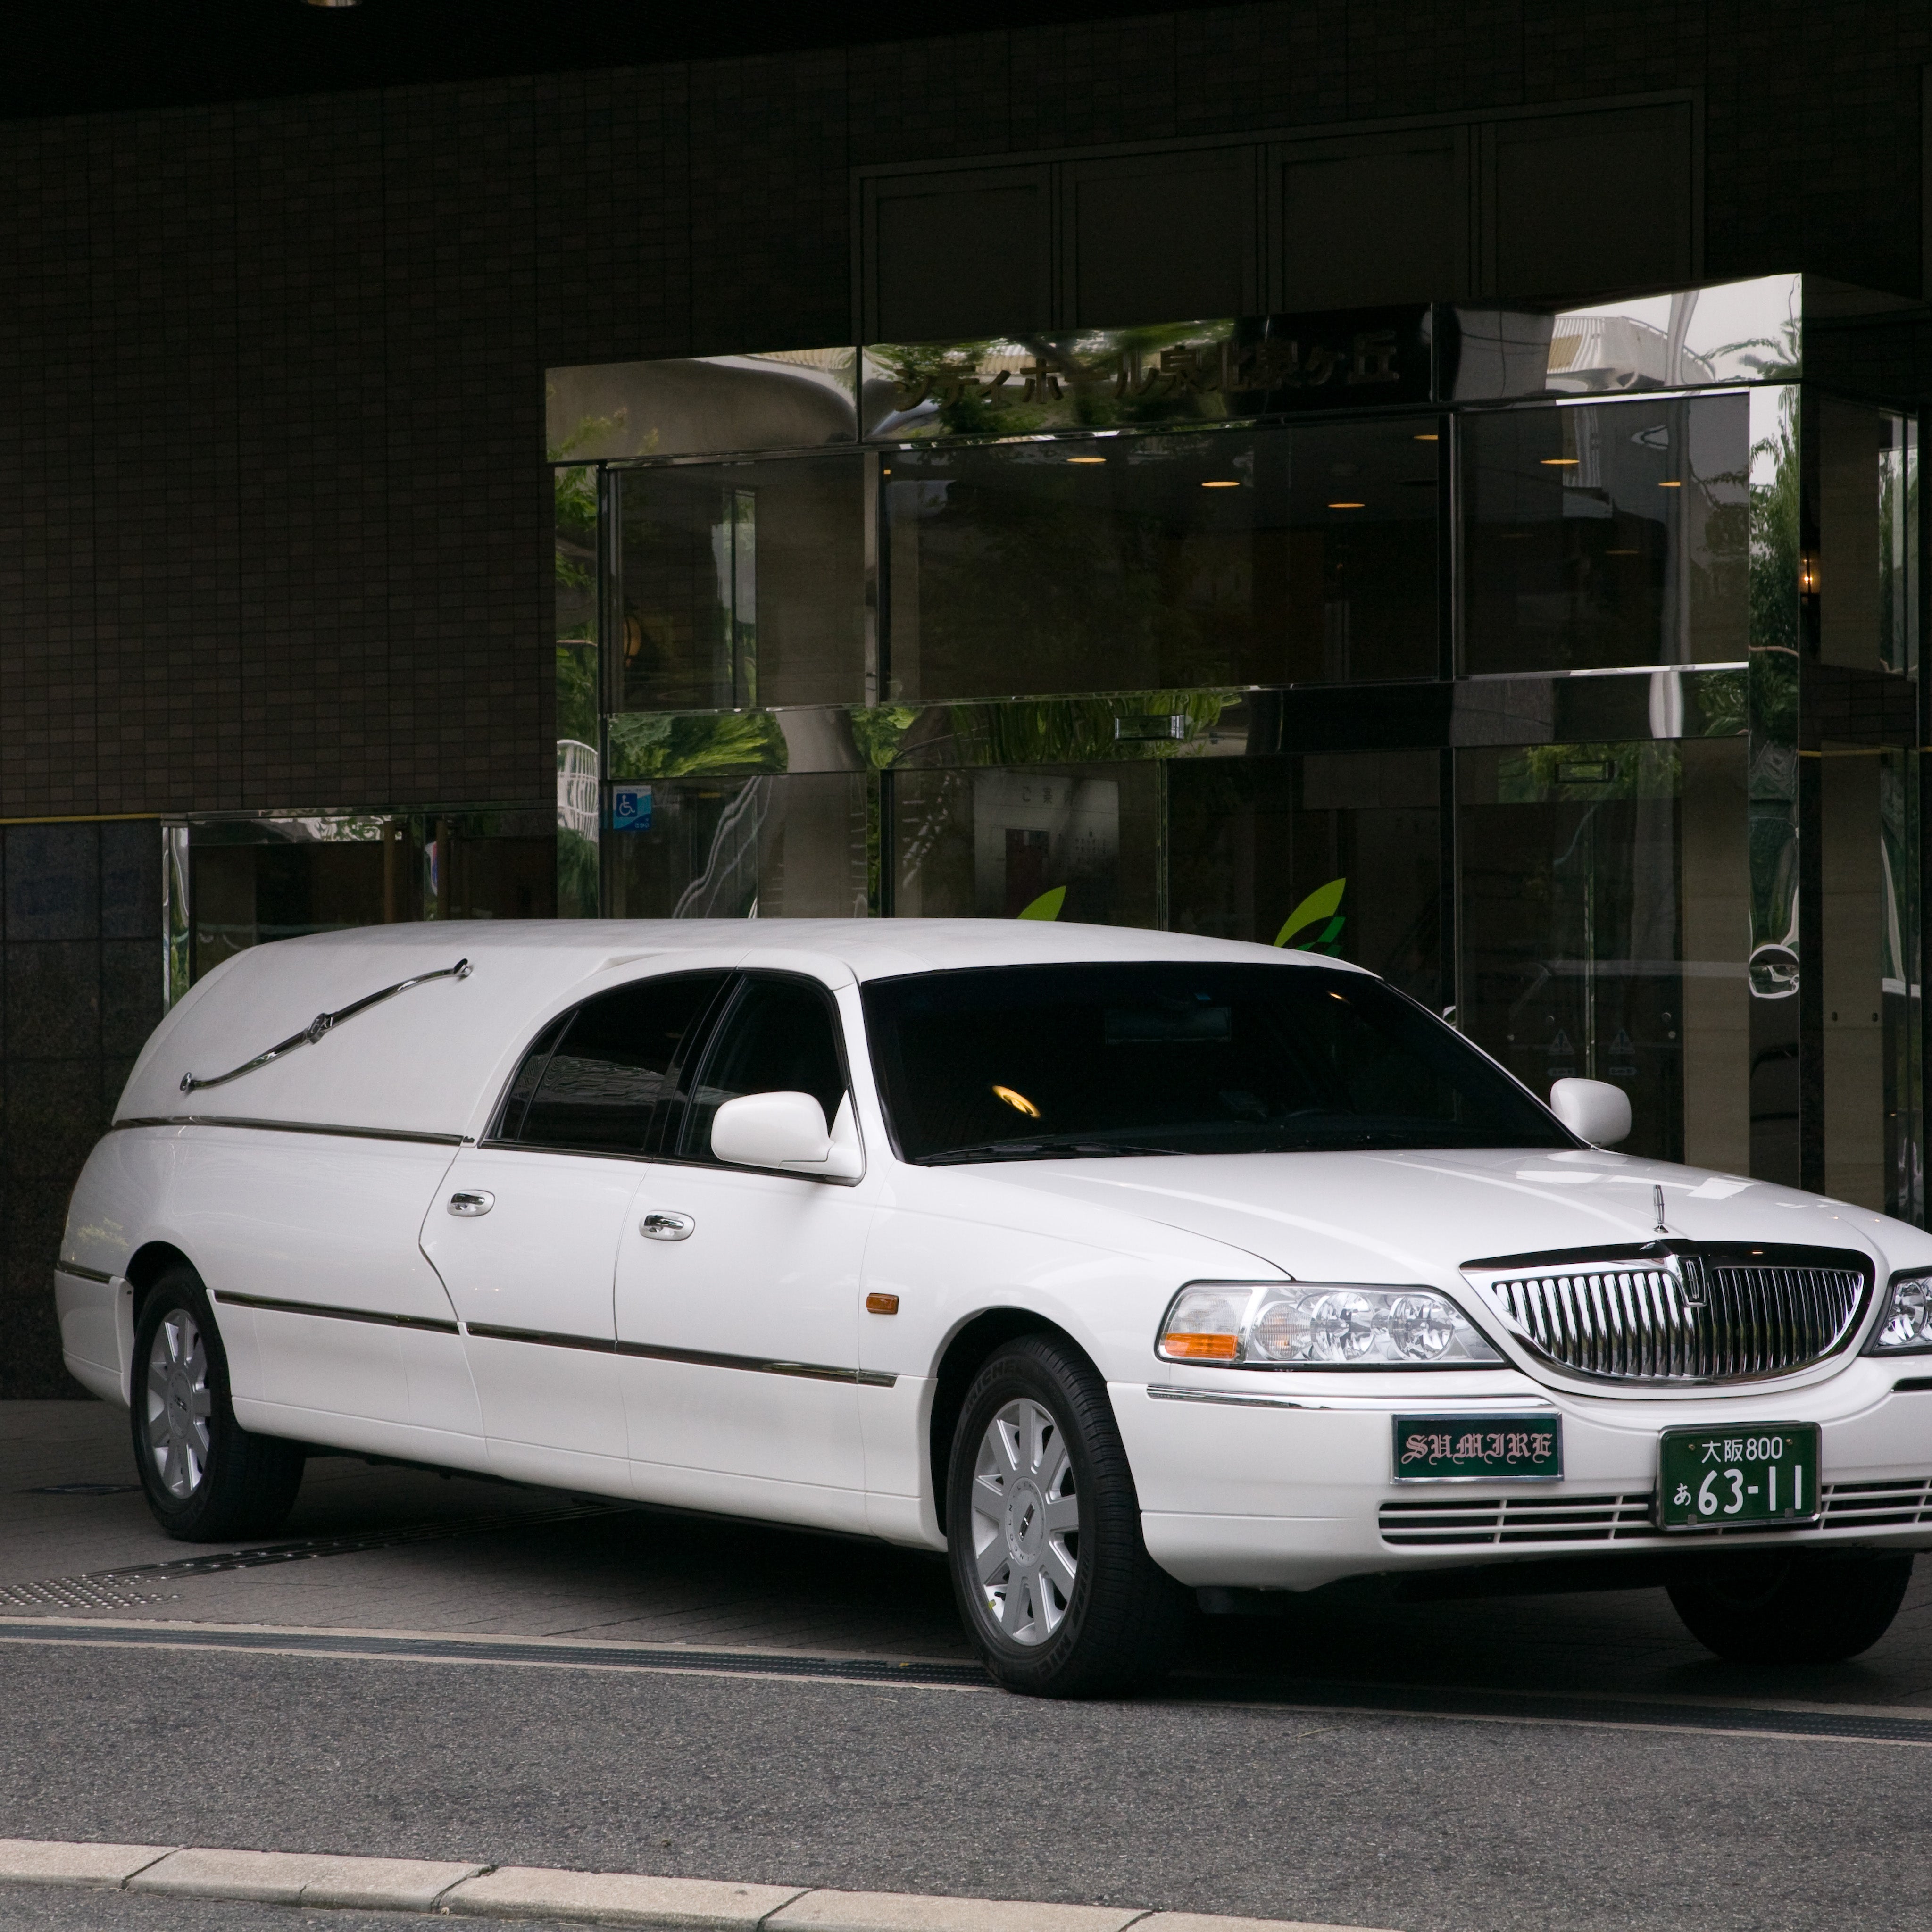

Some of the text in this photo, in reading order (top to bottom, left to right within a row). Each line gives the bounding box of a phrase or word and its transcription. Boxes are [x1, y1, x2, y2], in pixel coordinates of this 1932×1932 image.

[1401, 1433, 1553, 1465] SUMIRE
[1673, 1465, 1802, 1516] あ 63-11
